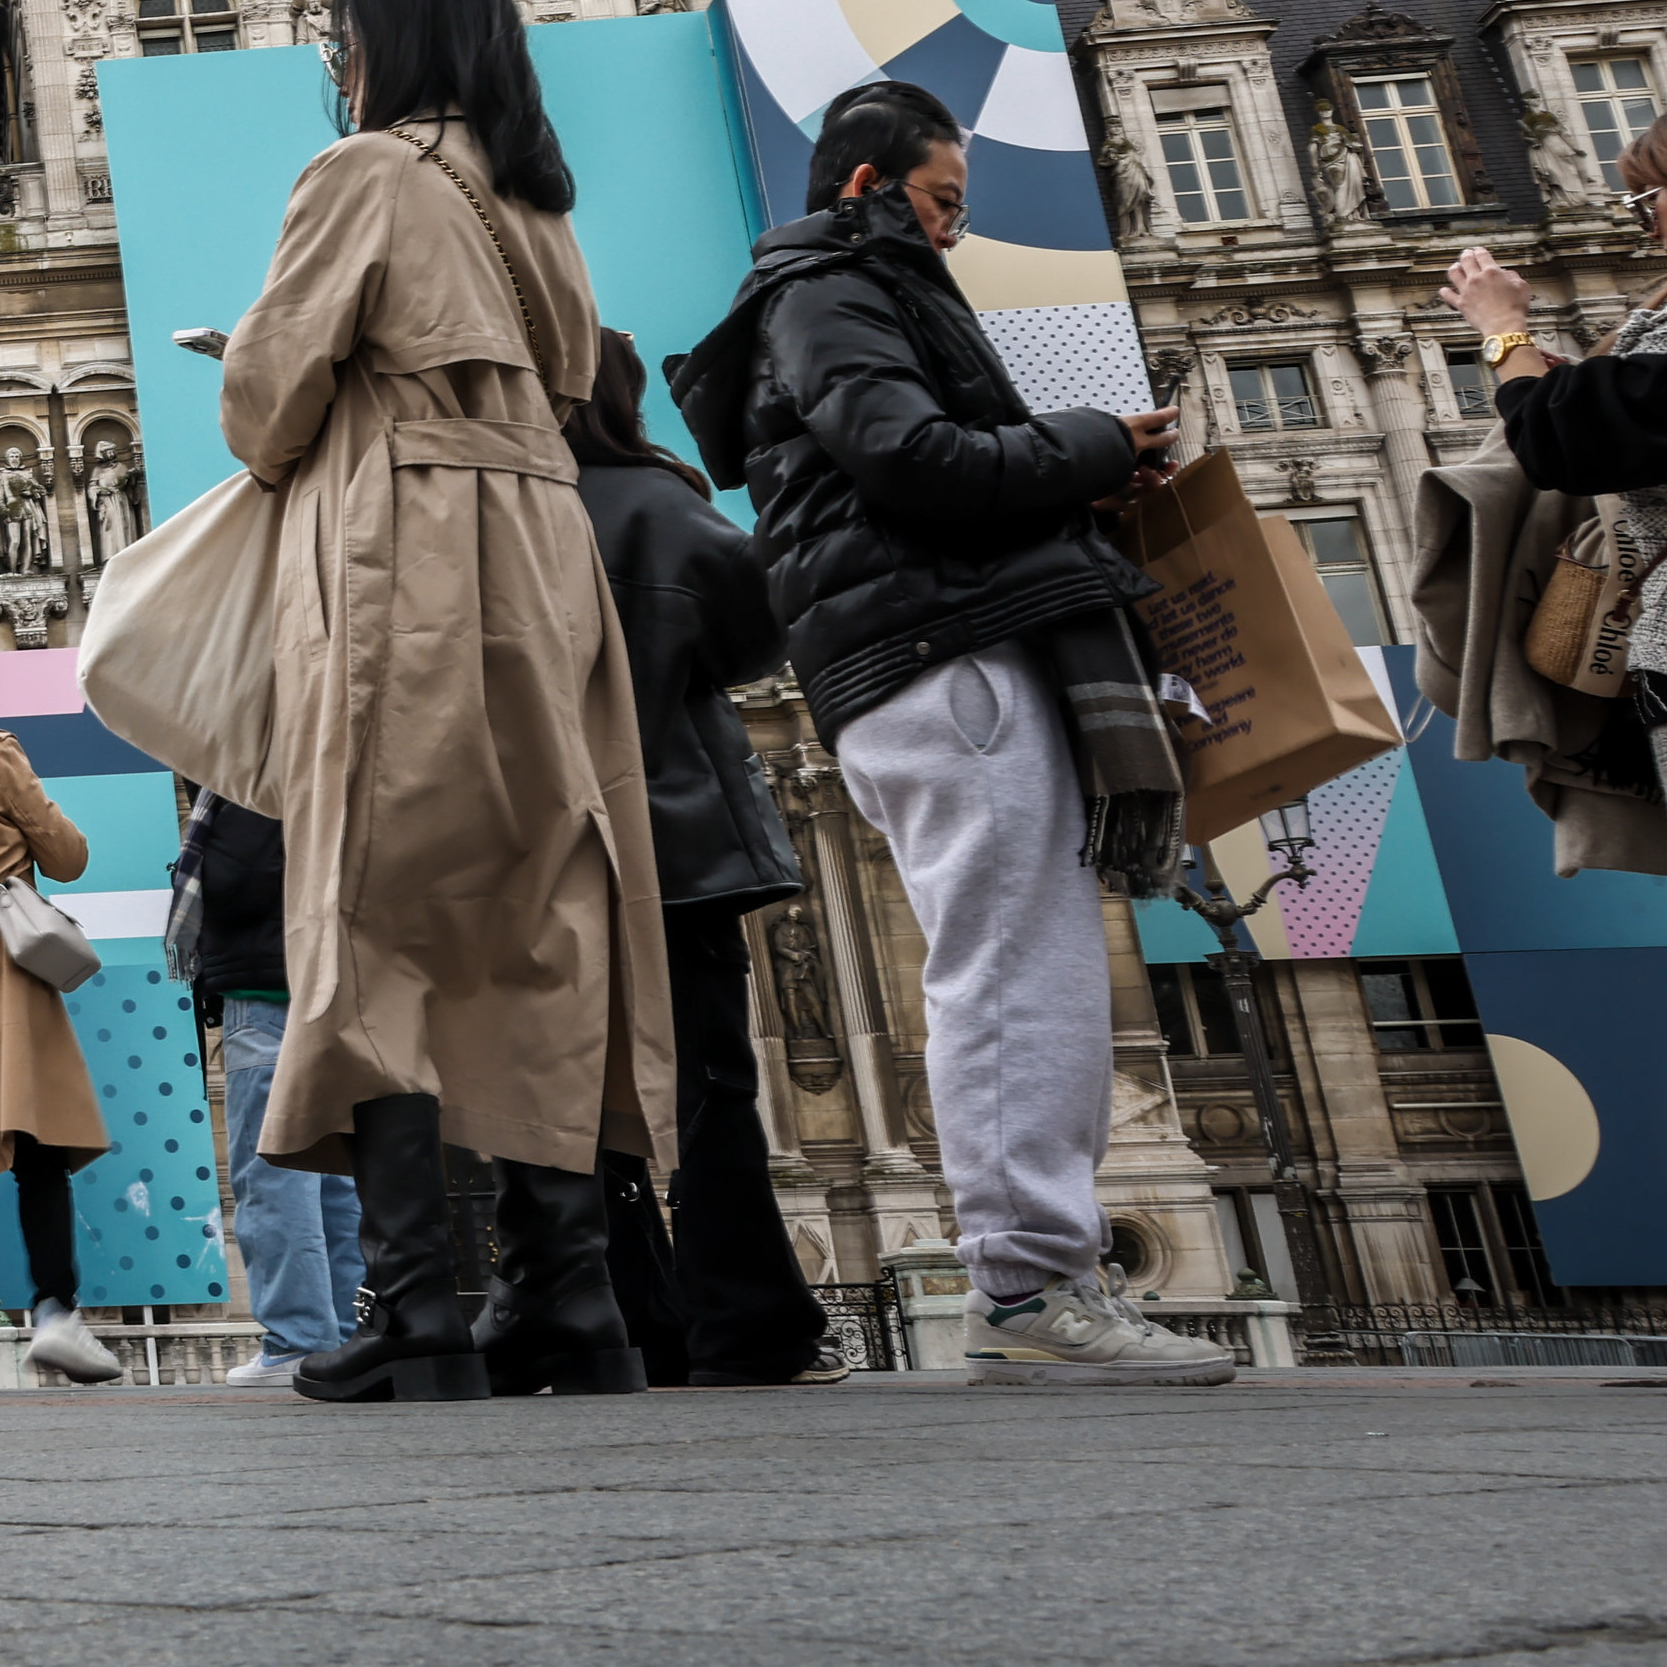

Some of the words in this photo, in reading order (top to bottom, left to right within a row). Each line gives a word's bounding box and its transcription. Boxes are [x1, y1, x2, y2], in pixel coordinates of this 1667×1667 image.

[1148, 598, 1169, 616] Let
[1171, 591, 1187, 605] us
[1160, 609, 1178, 625] let
[1180, 602, 1197, 615] us
[1196, 603, 1221, 623] two
[1159, 612, 1235, 652] musements
[1183, 636, 1217, 659] never
[1221, 625, 1238, 642] do
[1195, 645, 1233, 669] harm
